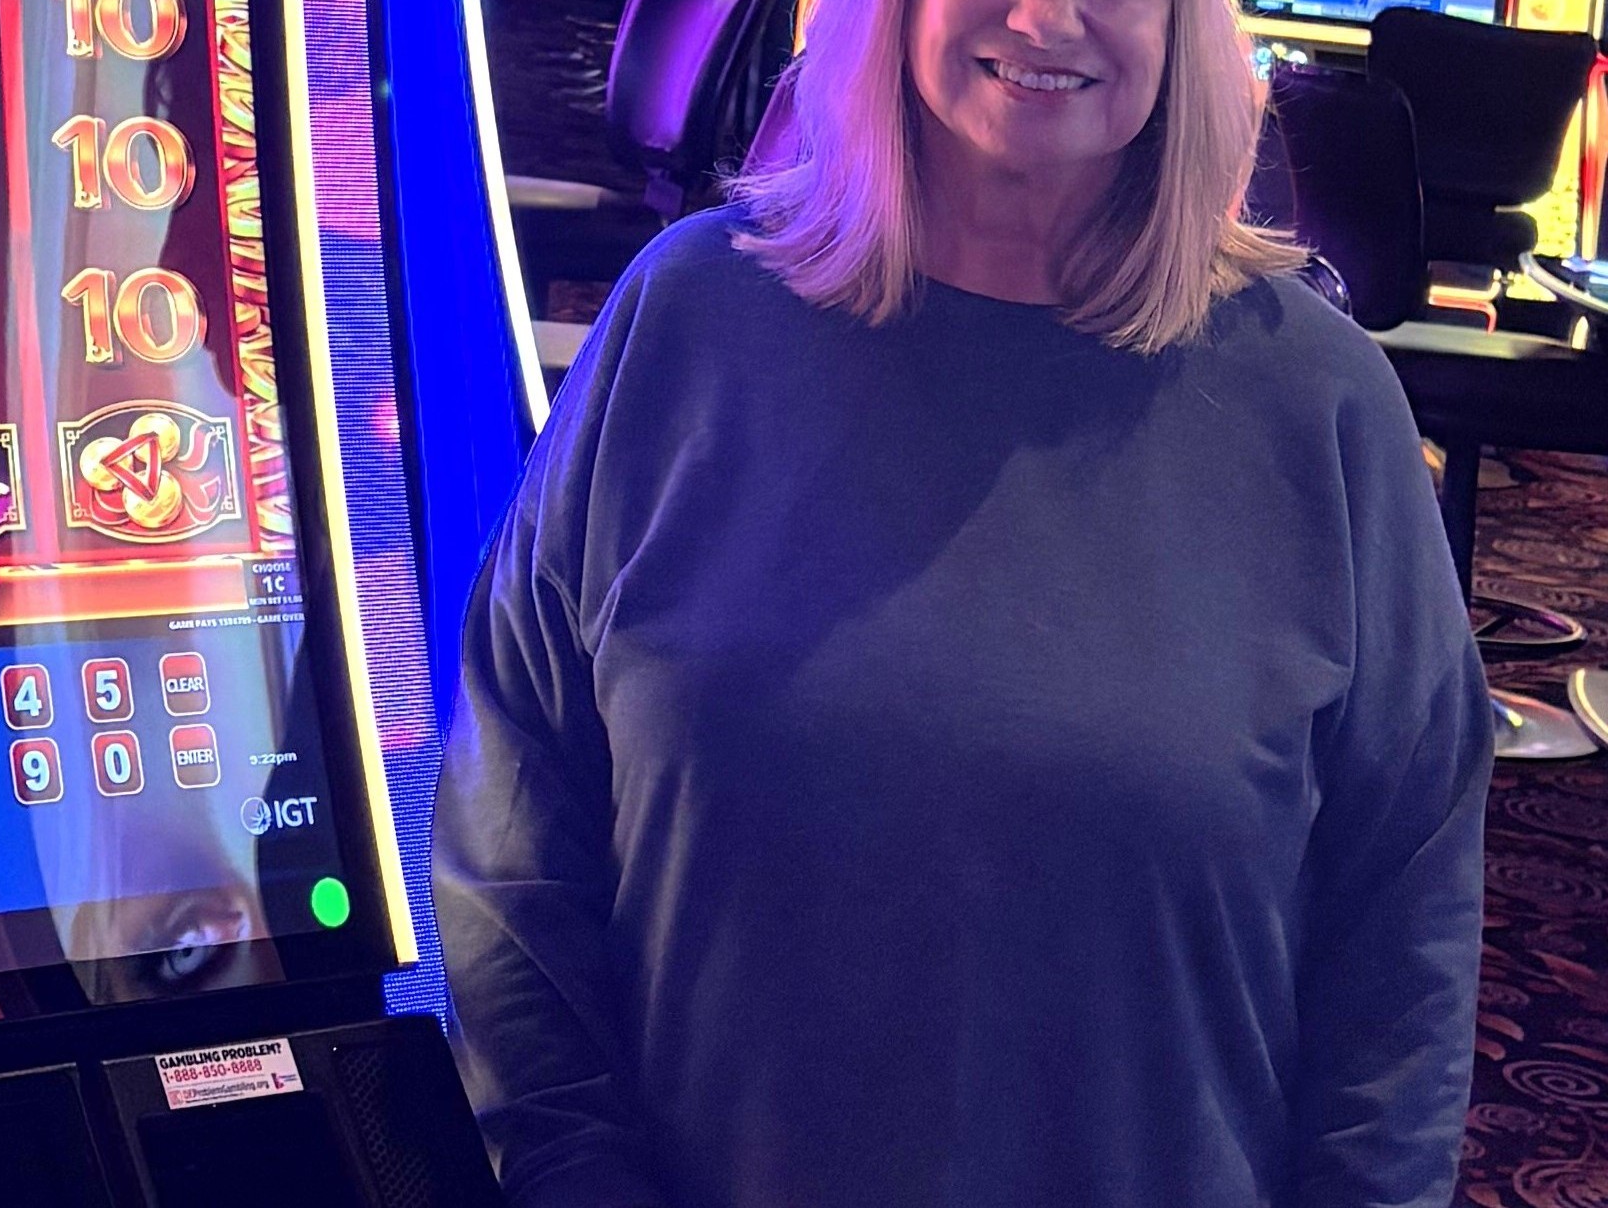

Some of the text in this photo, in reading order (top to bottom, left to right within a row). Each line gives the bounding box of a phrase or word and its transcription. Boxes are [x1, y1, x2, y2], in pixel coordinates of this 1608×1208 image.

[50, 113, 196, 211] 10
[60, 267, 207, 367] 10
[253, 562, 291, 573] CHOOSE
[14, 676, 41, 717] 4
[96, 670, 119, 711] 5
[166, 677, 205, 693] CLEAR
[24, 749, 50, 791] 9
[107, 743, 130, 784] 0
[177, 749, 215, 766] ENTER
[274, 797, 317, 828] IGT
[159, 1043, 282, 1070] GAMBLING PROBLEM?
[163, 1058, 262, 1084] 1-888-850-8888
